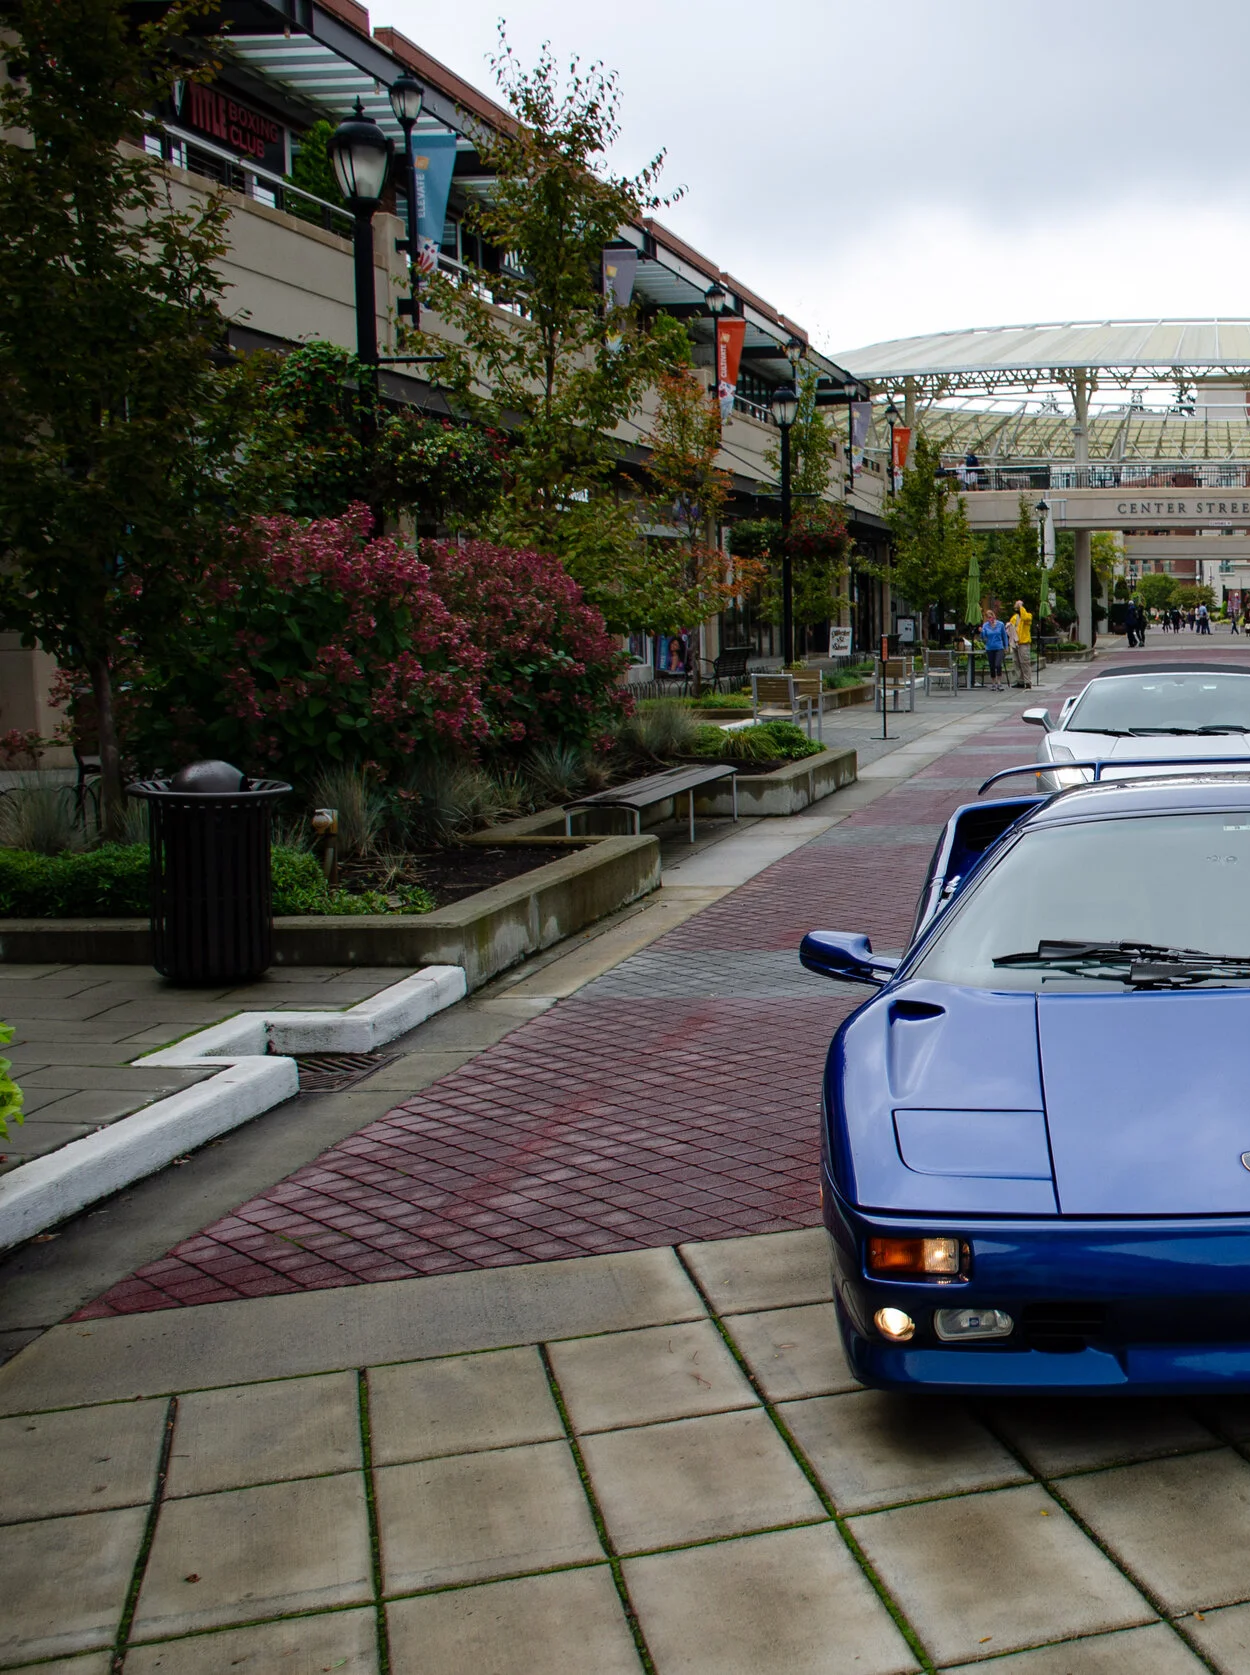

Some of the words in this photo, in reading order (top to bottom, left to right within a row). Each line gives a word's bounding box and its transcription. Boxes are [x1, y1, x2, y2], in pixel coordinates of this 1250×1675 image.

[188, 80, 227, 140] TITLE
[228, 98, 279, 144] BOXING
[228, 124, 265, 158] CLUB
[415, 173, 426, 218] ELEVATE
[720, 344, 728, 378] CULTIVATE
[1117, 502, 1187, 514] CENTER
